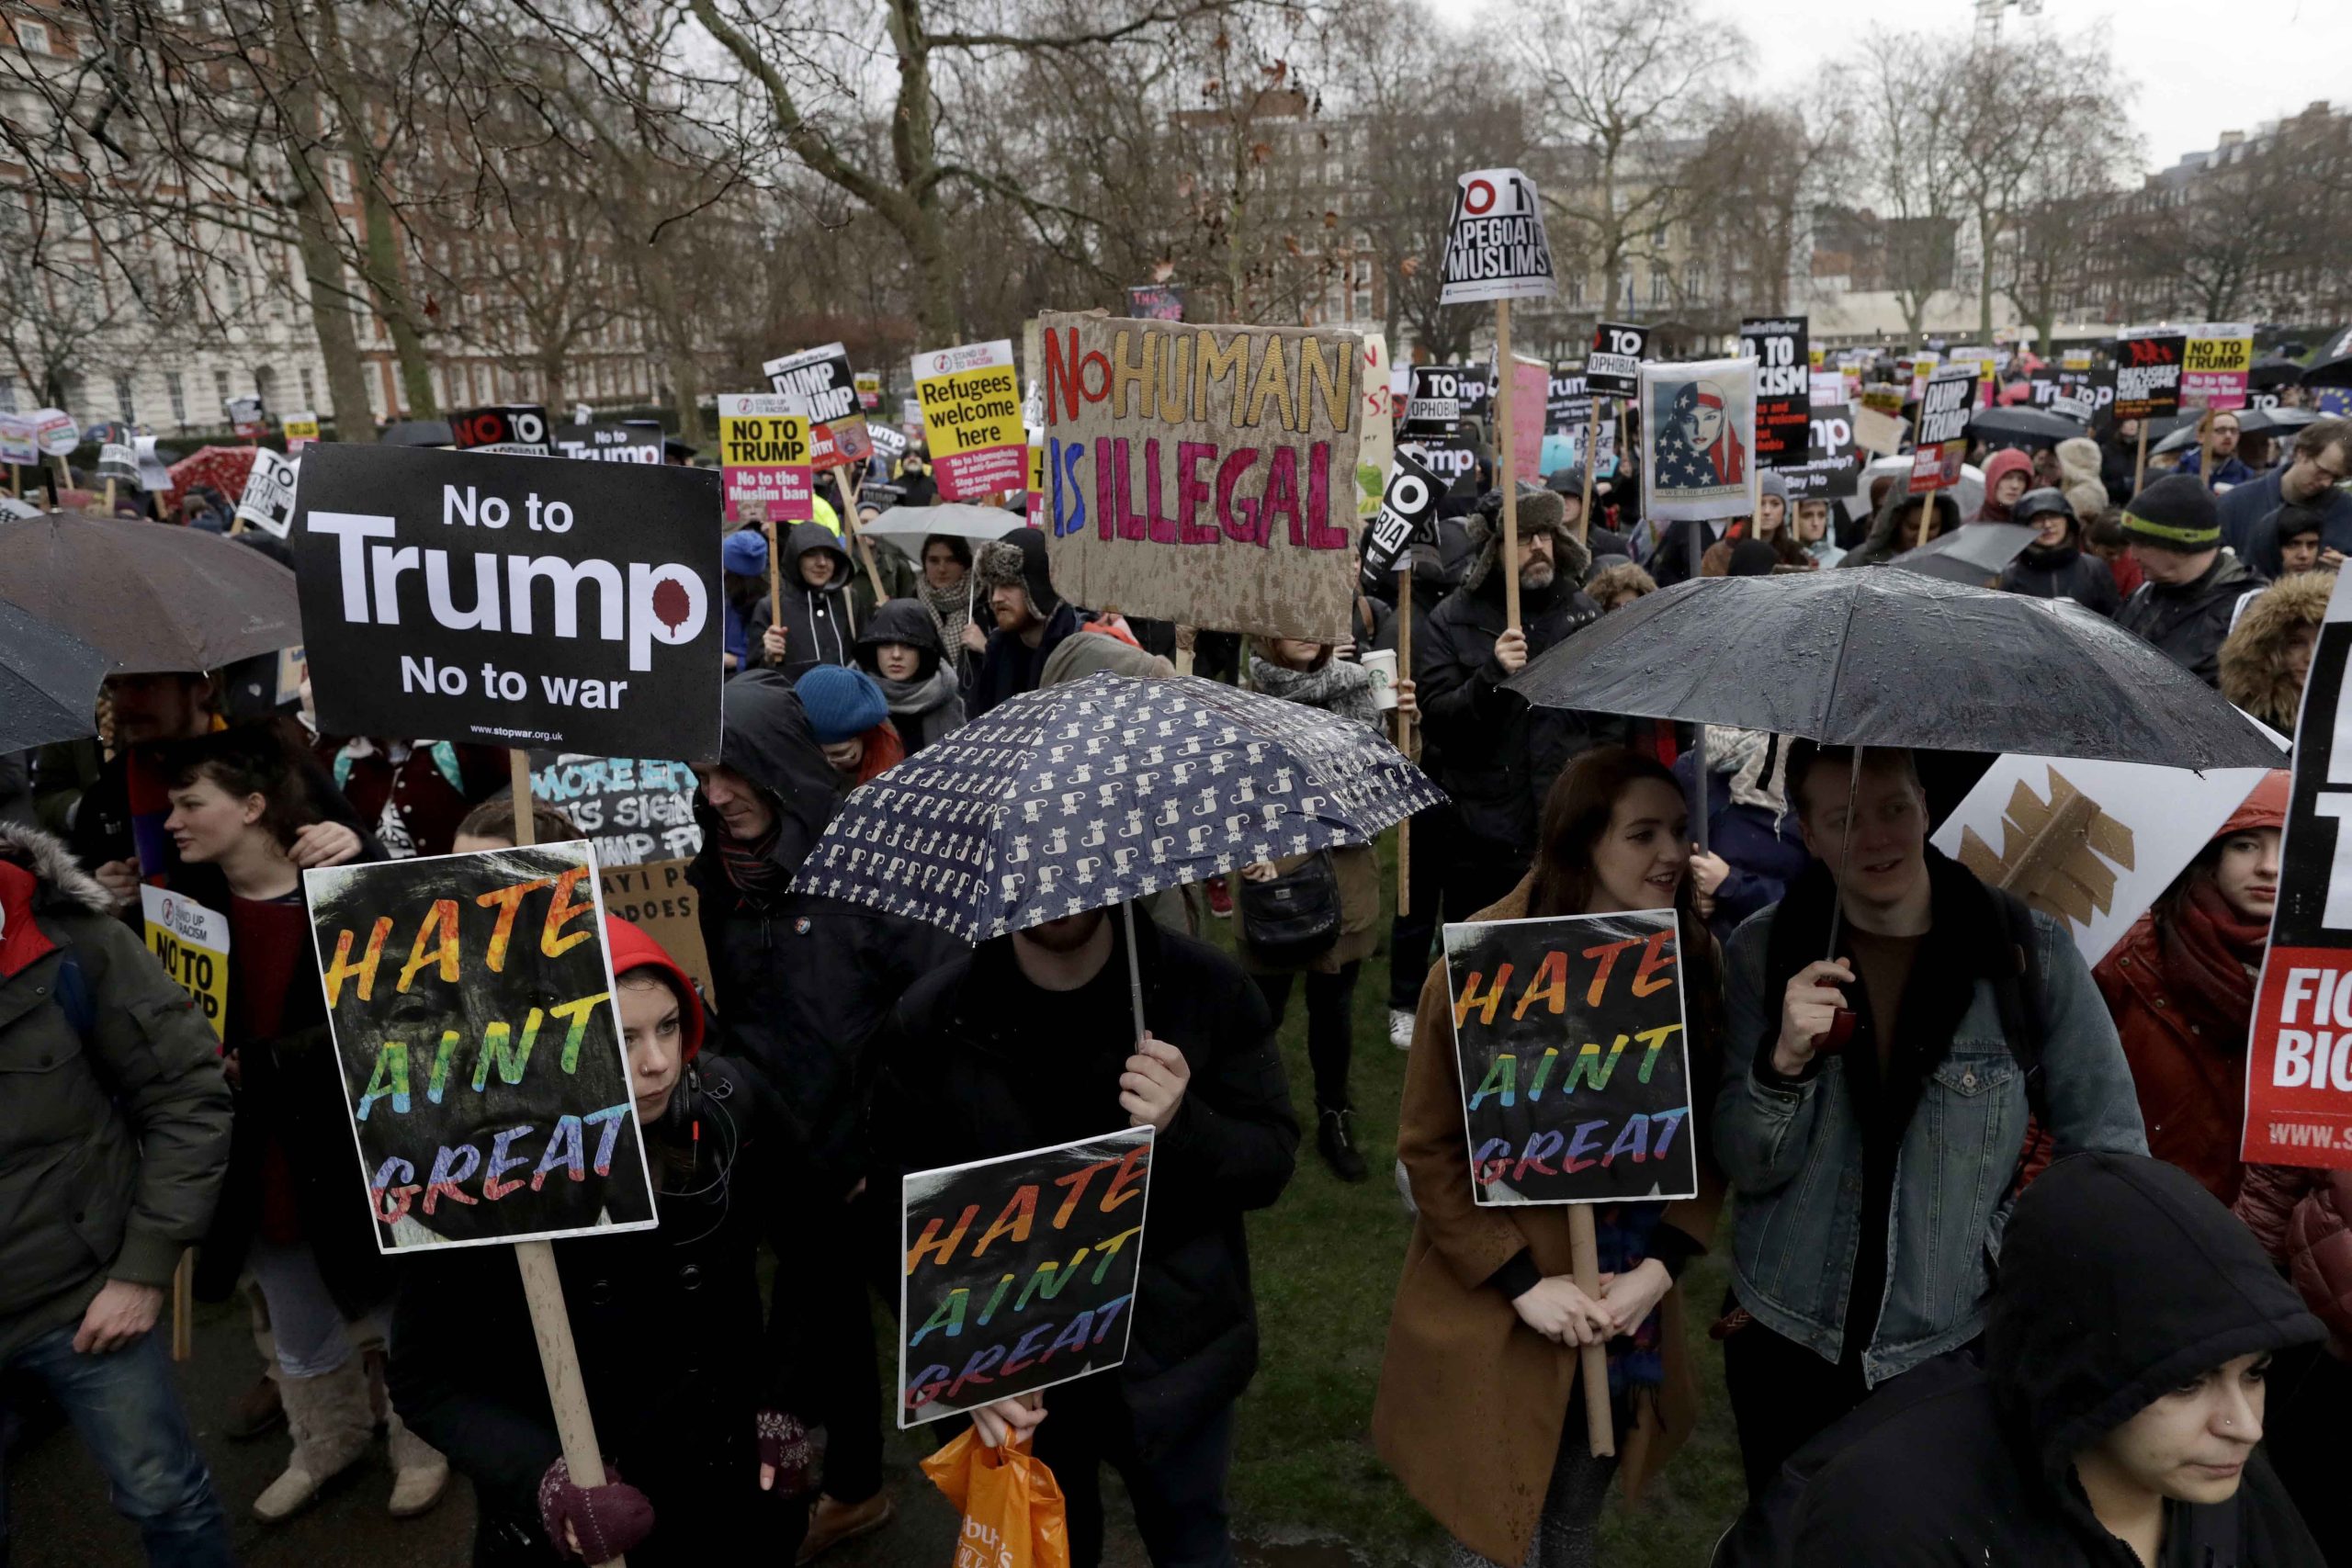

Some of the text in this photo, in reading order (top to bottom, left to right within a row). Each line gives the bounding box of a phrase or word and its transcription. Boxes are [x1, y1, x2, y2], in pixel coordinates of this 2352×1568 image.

[1449, 245, 1547, 281] MUSLIMS
[953, 351, 977, 361] STAND
[1609, 329, 1642, 355] TO
[1764, 336, 1794, 367] TO
[2191, 341, 2242, 355] NO TO
[967, 356, 993, 367] RACISM
[2187, 355, 2245, 368] TRUMP
[772, 362, 834, 395] DUMP
[922, 375, 1012, 405] Refugees
[1113, 330, 1352, 434] HUMAN
[1428, 373, 1458, 398] TO
[806, 386, 854, 424] UMP
[1364, 385, 1390, 417] S?
[1925, 380, 1969, 413] DUMP
[2030, 379, 2113, 410] Trp
[2252, 395, 2278, 410] TO
[930, 400, 1014, 428] welcome
[1921, 408, 1970, 444] TRUMP
[453, 413, 504, 449] NO
[507, 413, 543, 444] TO
[594, 431, 628, 445] No to
[732, 420, 797, 440] NO TO
[866, 423, 906, 448] ump
[956, 425, 1001, 448] here
[559, 441, 660, 463] Trump
[728, 442, 804, 462] TRUMP
[1807, 454, 1854, 470] onship?
[268, 457, 294, 488] TO
[737, 470, 799, 486] No to the
[1384, 459, 1429, 514] TO
[1785, 473, 1827, 490] Say No
[443, 484, 573, 533] No to
[729, 486, 808, 502] Muslim ban
[1049, 436, 1349, 550] IS ILLEGAL
[307, 511, 707, 671] Trump
[401, 655, 628, 709] No to war
[470, 724, 563, 742] www.stopwar.org.uk
[530, 757, 637, 802] MORE
[555, 799, 604, 831] IS
[601, 874, 630, 895] AY
[640, 871, 650, 890] I
[192, 914, 205, 926] UP
[625, 897, 691, 922] DOES
[324, 865, 594, 1009] HATE
[156, 931, 213, 990] NO TO
[1454, 930, 1676, 1029] HATE
[356, 992, 610, 1121] AINT
[1468, 1023, 1683, 1111] AINT
[1473, 1106, 1690, 1186] GREAT
[370, 1102, 632, 1224] GREAT
[906, 1144, 1152, 1276] HATE
[909, 1225, 1141, 1347] AINT
[905, 1292, 1133, 1409] GREAT
